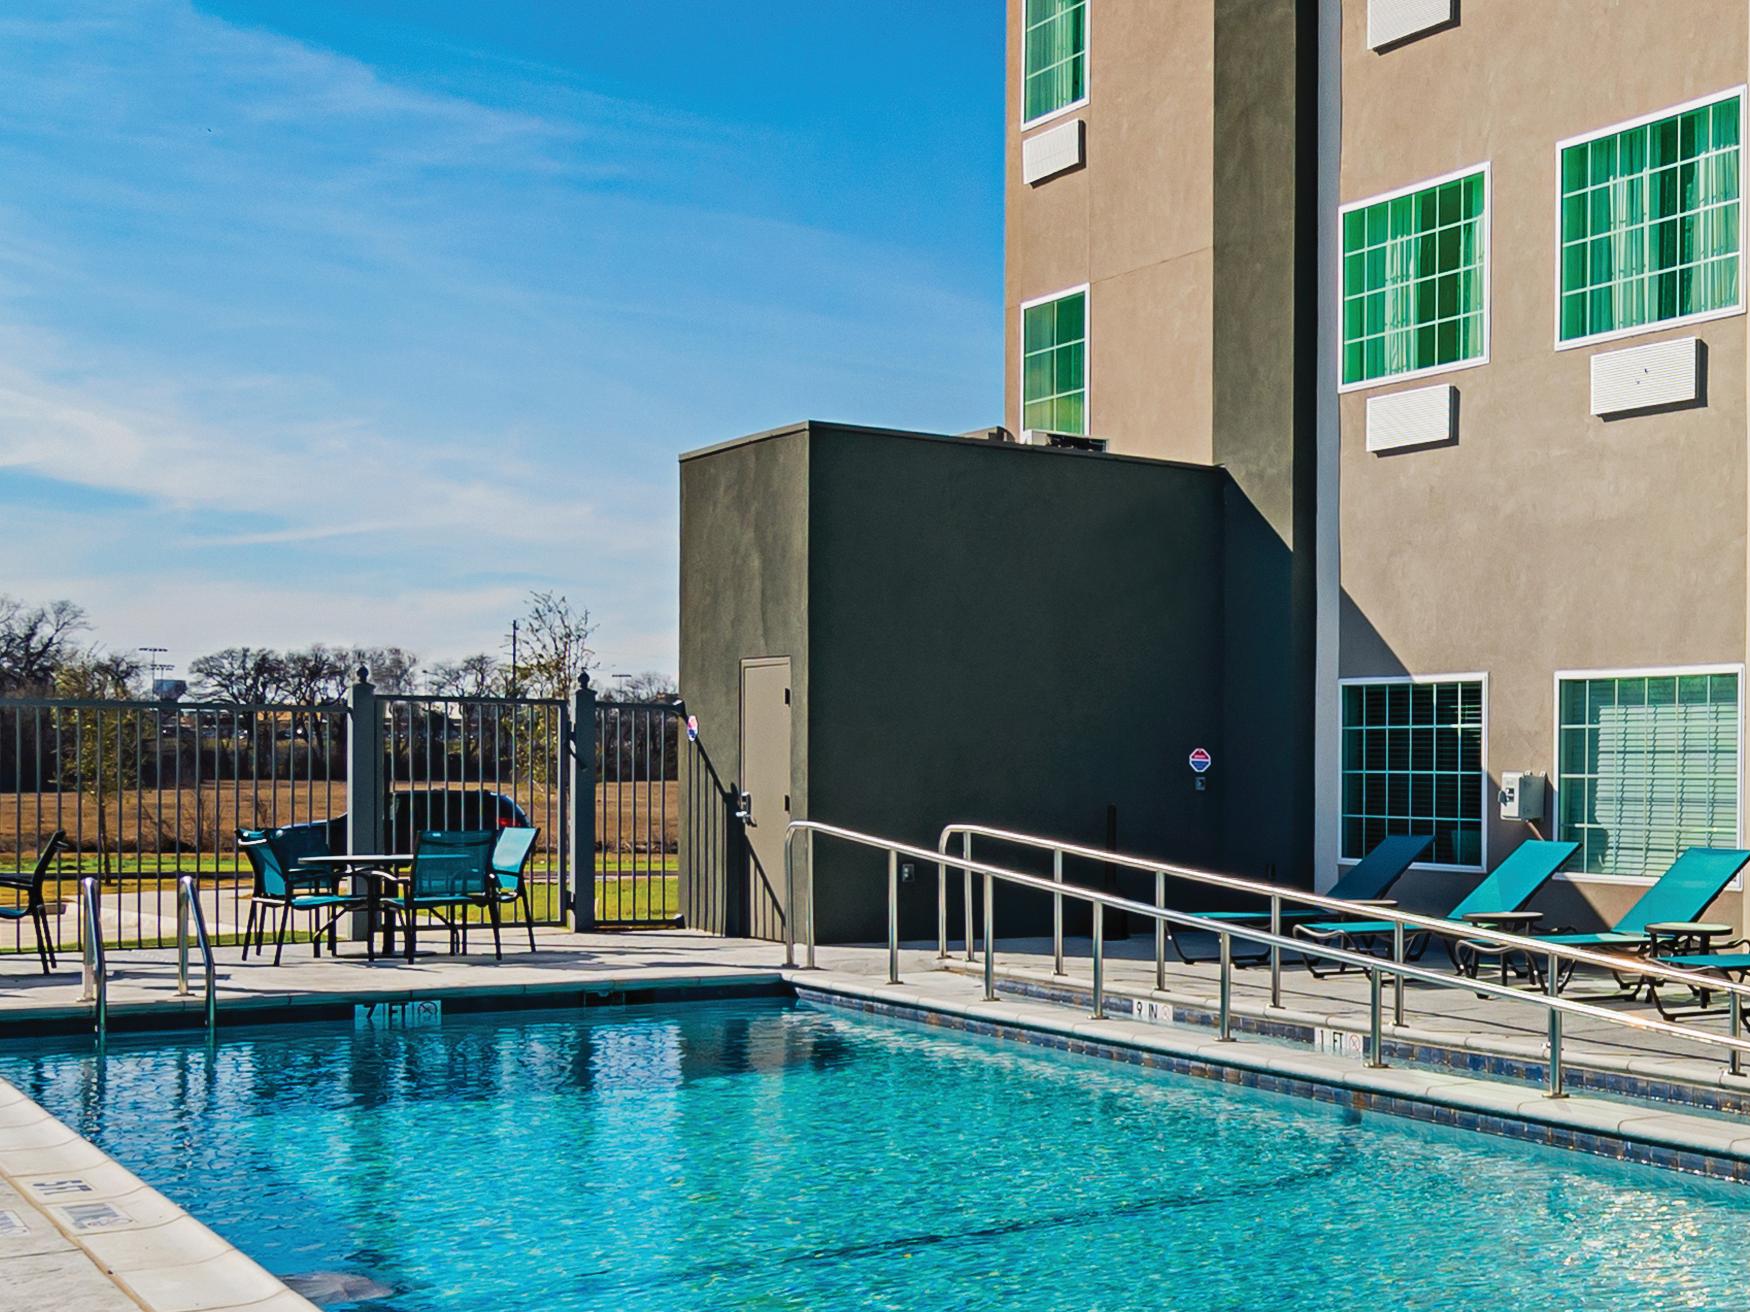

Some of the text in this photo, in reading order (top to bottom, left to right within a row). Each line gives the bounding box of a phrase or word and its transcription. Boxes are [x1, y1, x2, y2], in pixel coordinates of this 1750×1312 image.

[363, 1001, 409, 1023] 7 FT
[1137, 1001, 1158, 1018] 9 IN
[1333, 1031, 1343, 1051] FT
